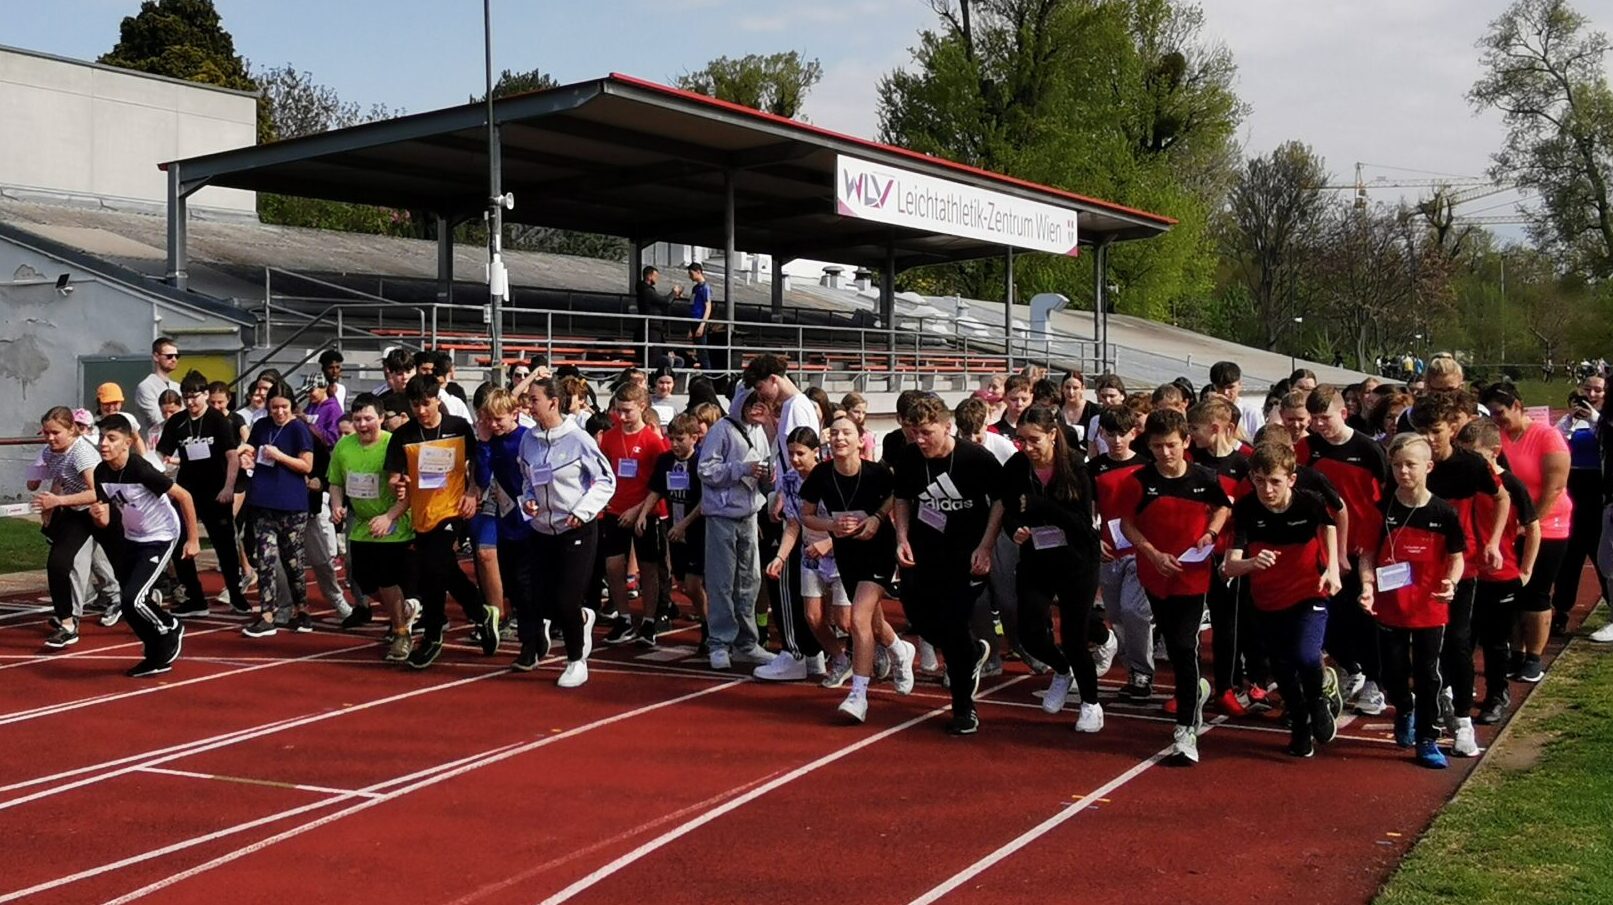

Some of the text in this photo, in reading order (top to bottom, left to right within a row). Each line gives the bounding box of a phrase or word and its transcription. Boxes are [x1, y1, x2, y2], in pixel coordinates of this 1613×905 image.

[843, 168, 894, 209] WLV
[897, 181, 1062, 244] Leichtathletik-Zentrum Wien
